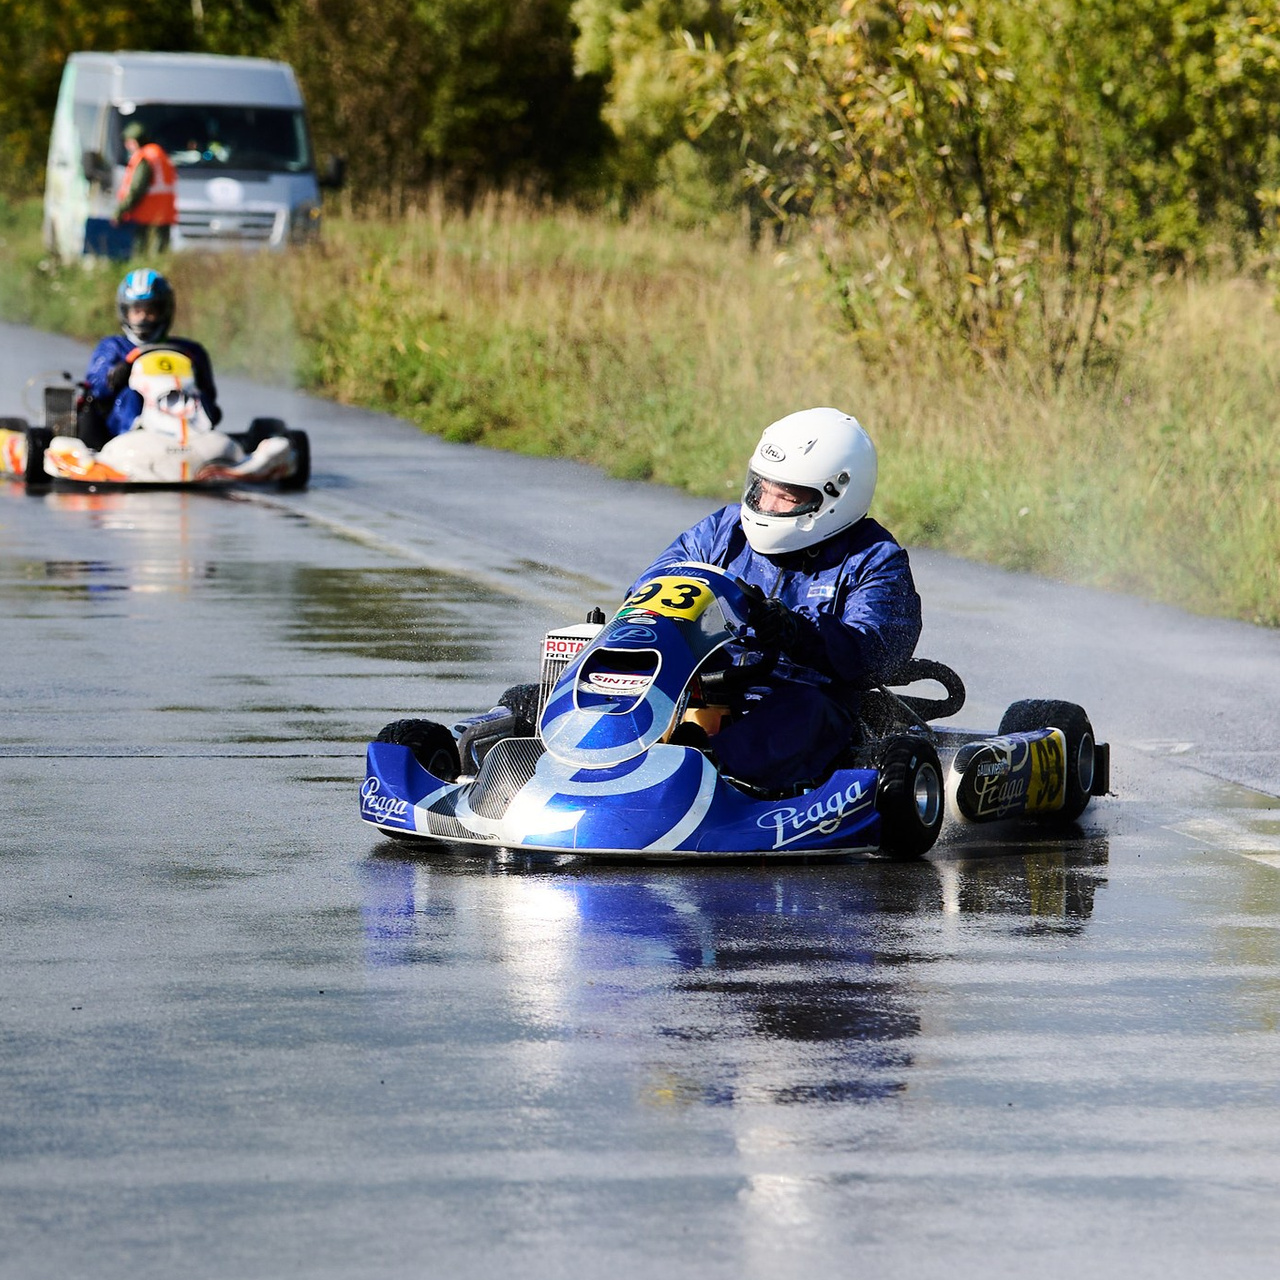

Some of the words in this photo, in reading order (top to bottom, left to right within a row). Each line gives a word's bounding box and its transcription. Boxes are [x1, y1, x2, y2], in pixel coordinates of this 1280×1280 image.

[624, 582, 702, 609] 93
[361, 776, 408, 823] Praga
[1035, 736, 1061, 805] 93
[756, 780, 869, 849] Praga
